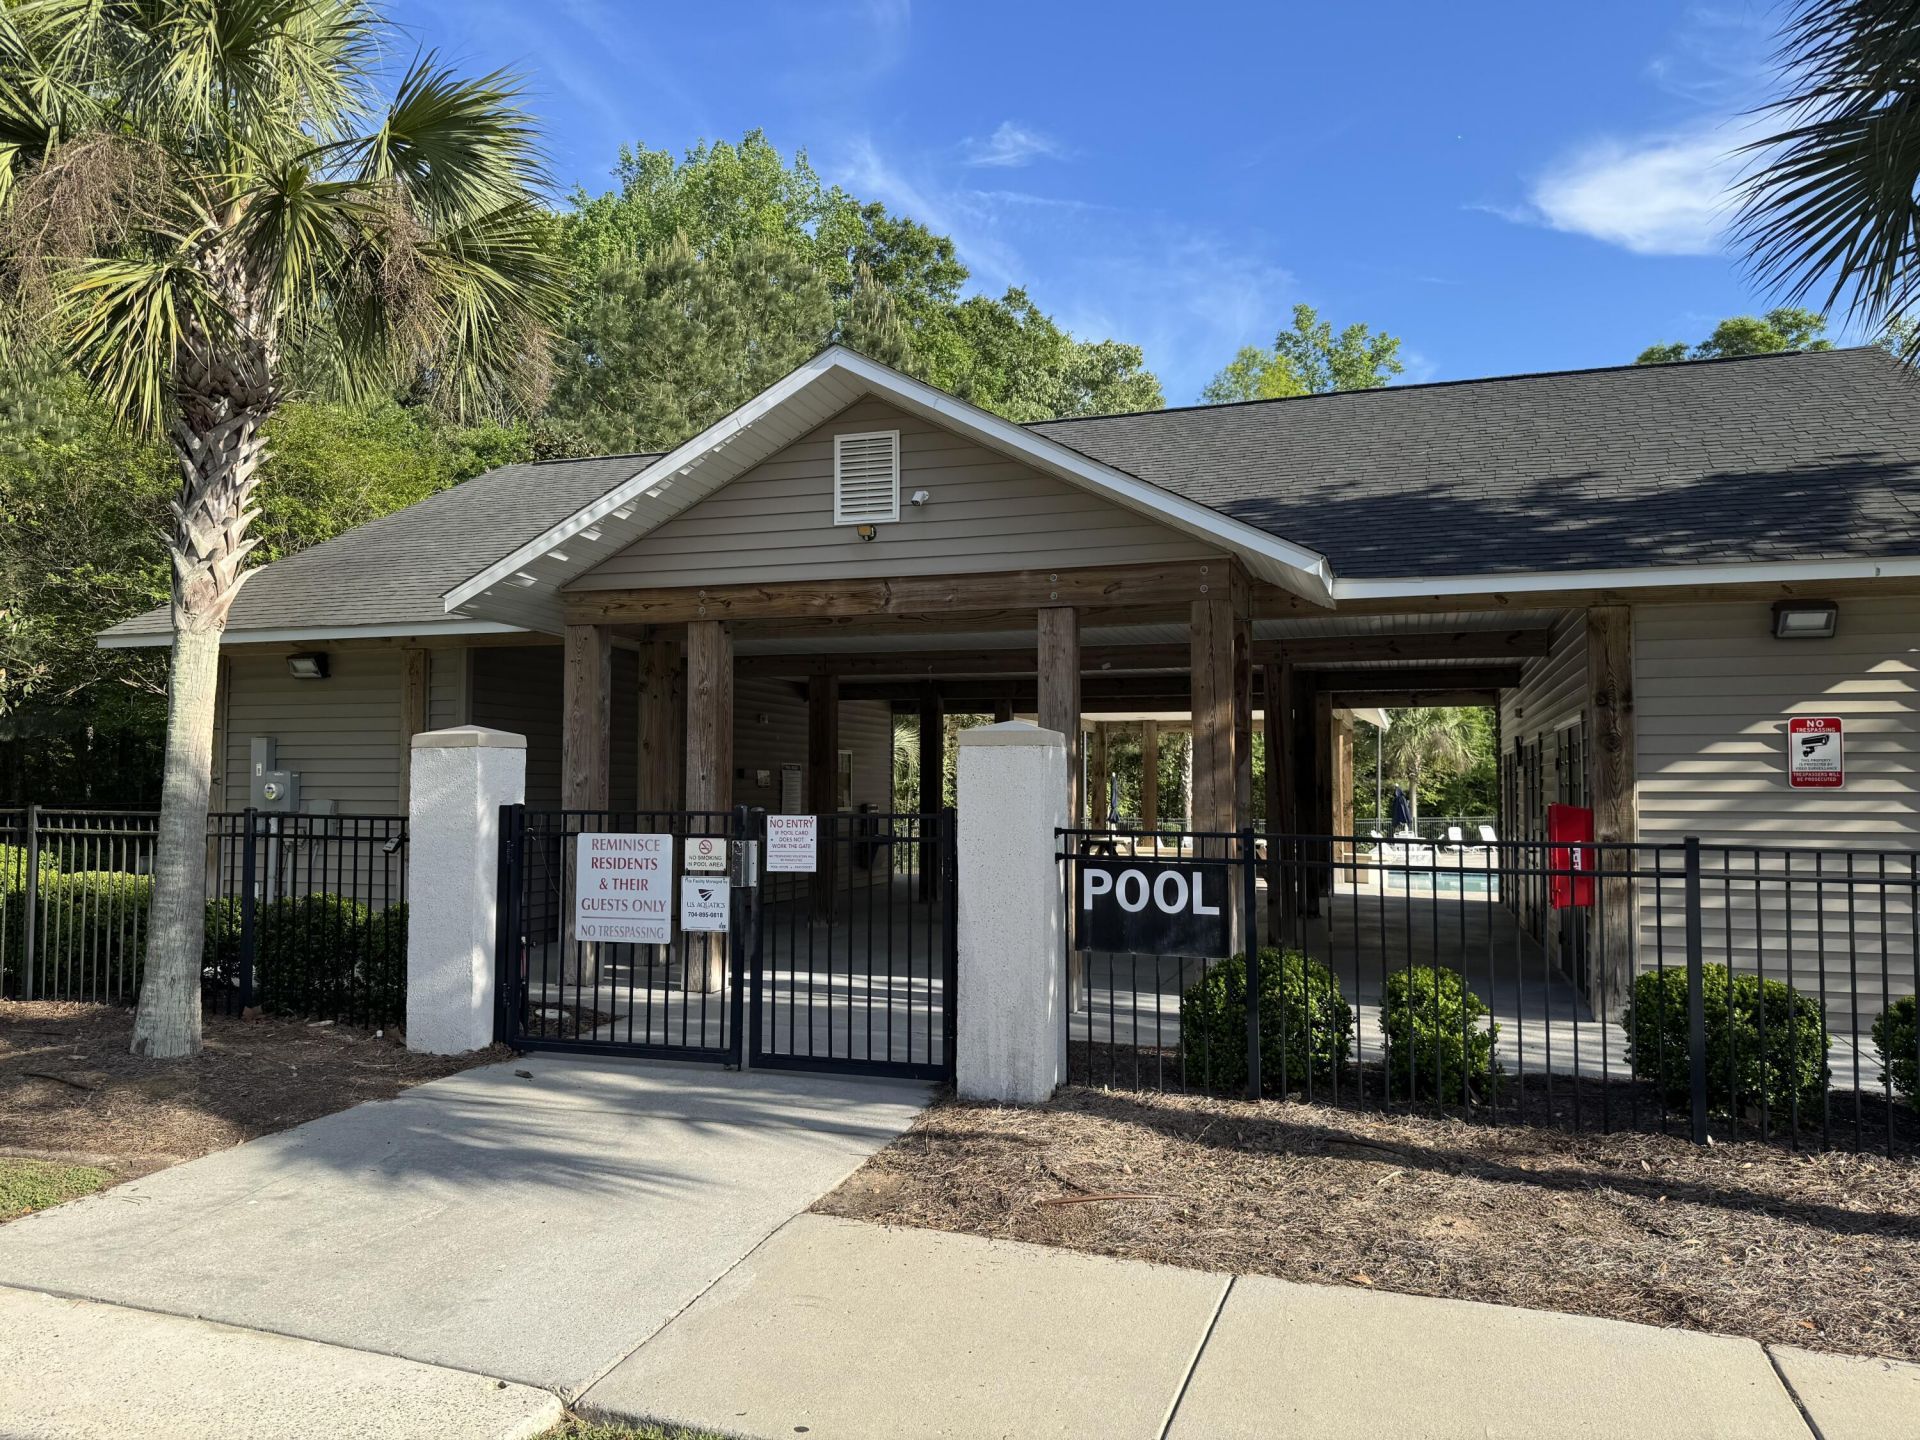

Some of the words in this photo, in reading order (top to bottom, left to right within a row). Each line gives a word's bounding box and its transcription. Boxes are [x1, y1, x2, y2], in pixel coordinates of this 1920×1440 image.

[770, 819, 783, 828] NO
[787, 819, 814, 828] ENTRY
[592, 838, 660, 851] REMINISCE
[592, 857, 658, 870] RESIDENTS
[599, 878, 608, 890] &
[612, 878, 648, 891] THEIR
[1084, 869, 1219, 915] POOL
[581, 898, 628, 912] GUESTS
[632, 899, 667, 912] ONLY
[581, 925, 596, 937] NO
[599, 925, 664, 939] TRESSPASSING
